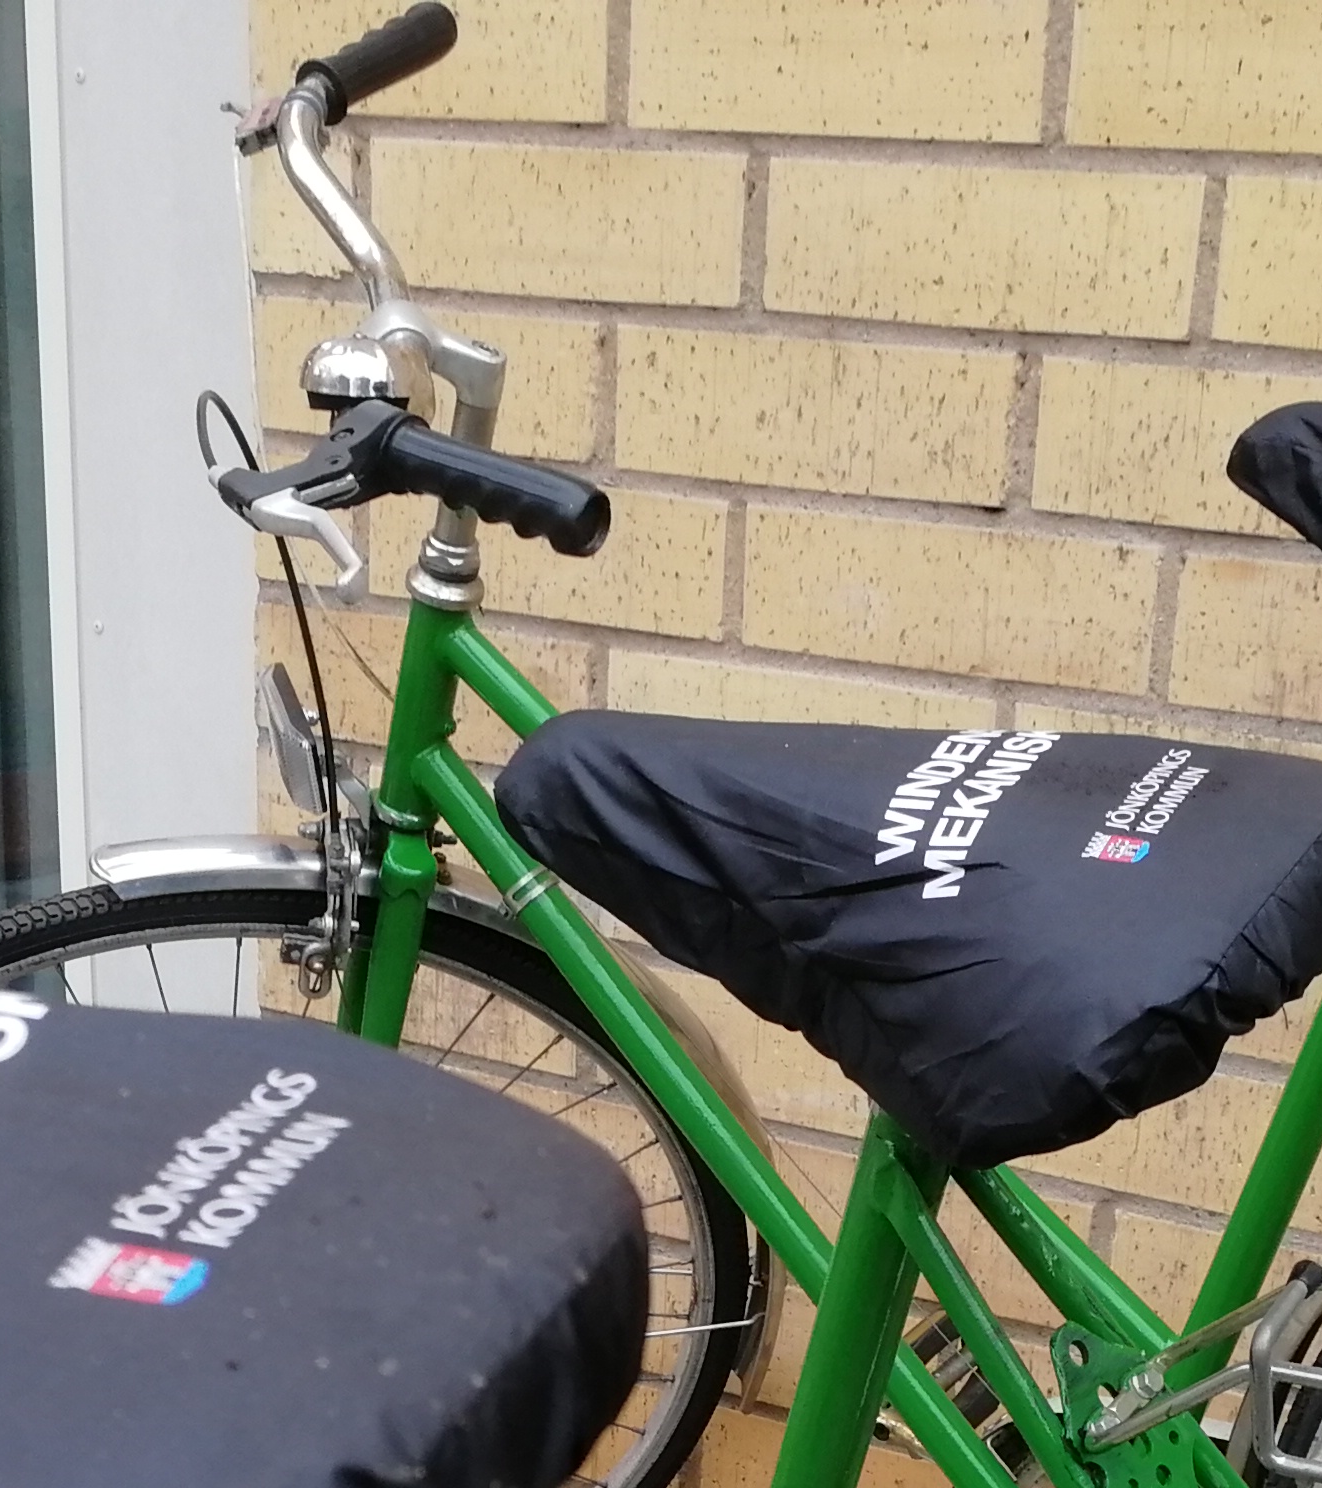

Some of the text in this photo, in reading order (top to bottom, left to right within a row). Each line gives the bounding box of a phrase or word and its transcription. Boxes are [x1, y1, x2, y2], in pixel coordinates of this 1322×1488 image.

[1104, 748, 1192, 832] JÖNKÖPINGS
[1136, 766, 1210, 835] KOMMUN
[177, 1110, 354, 1249] KOMMUN
